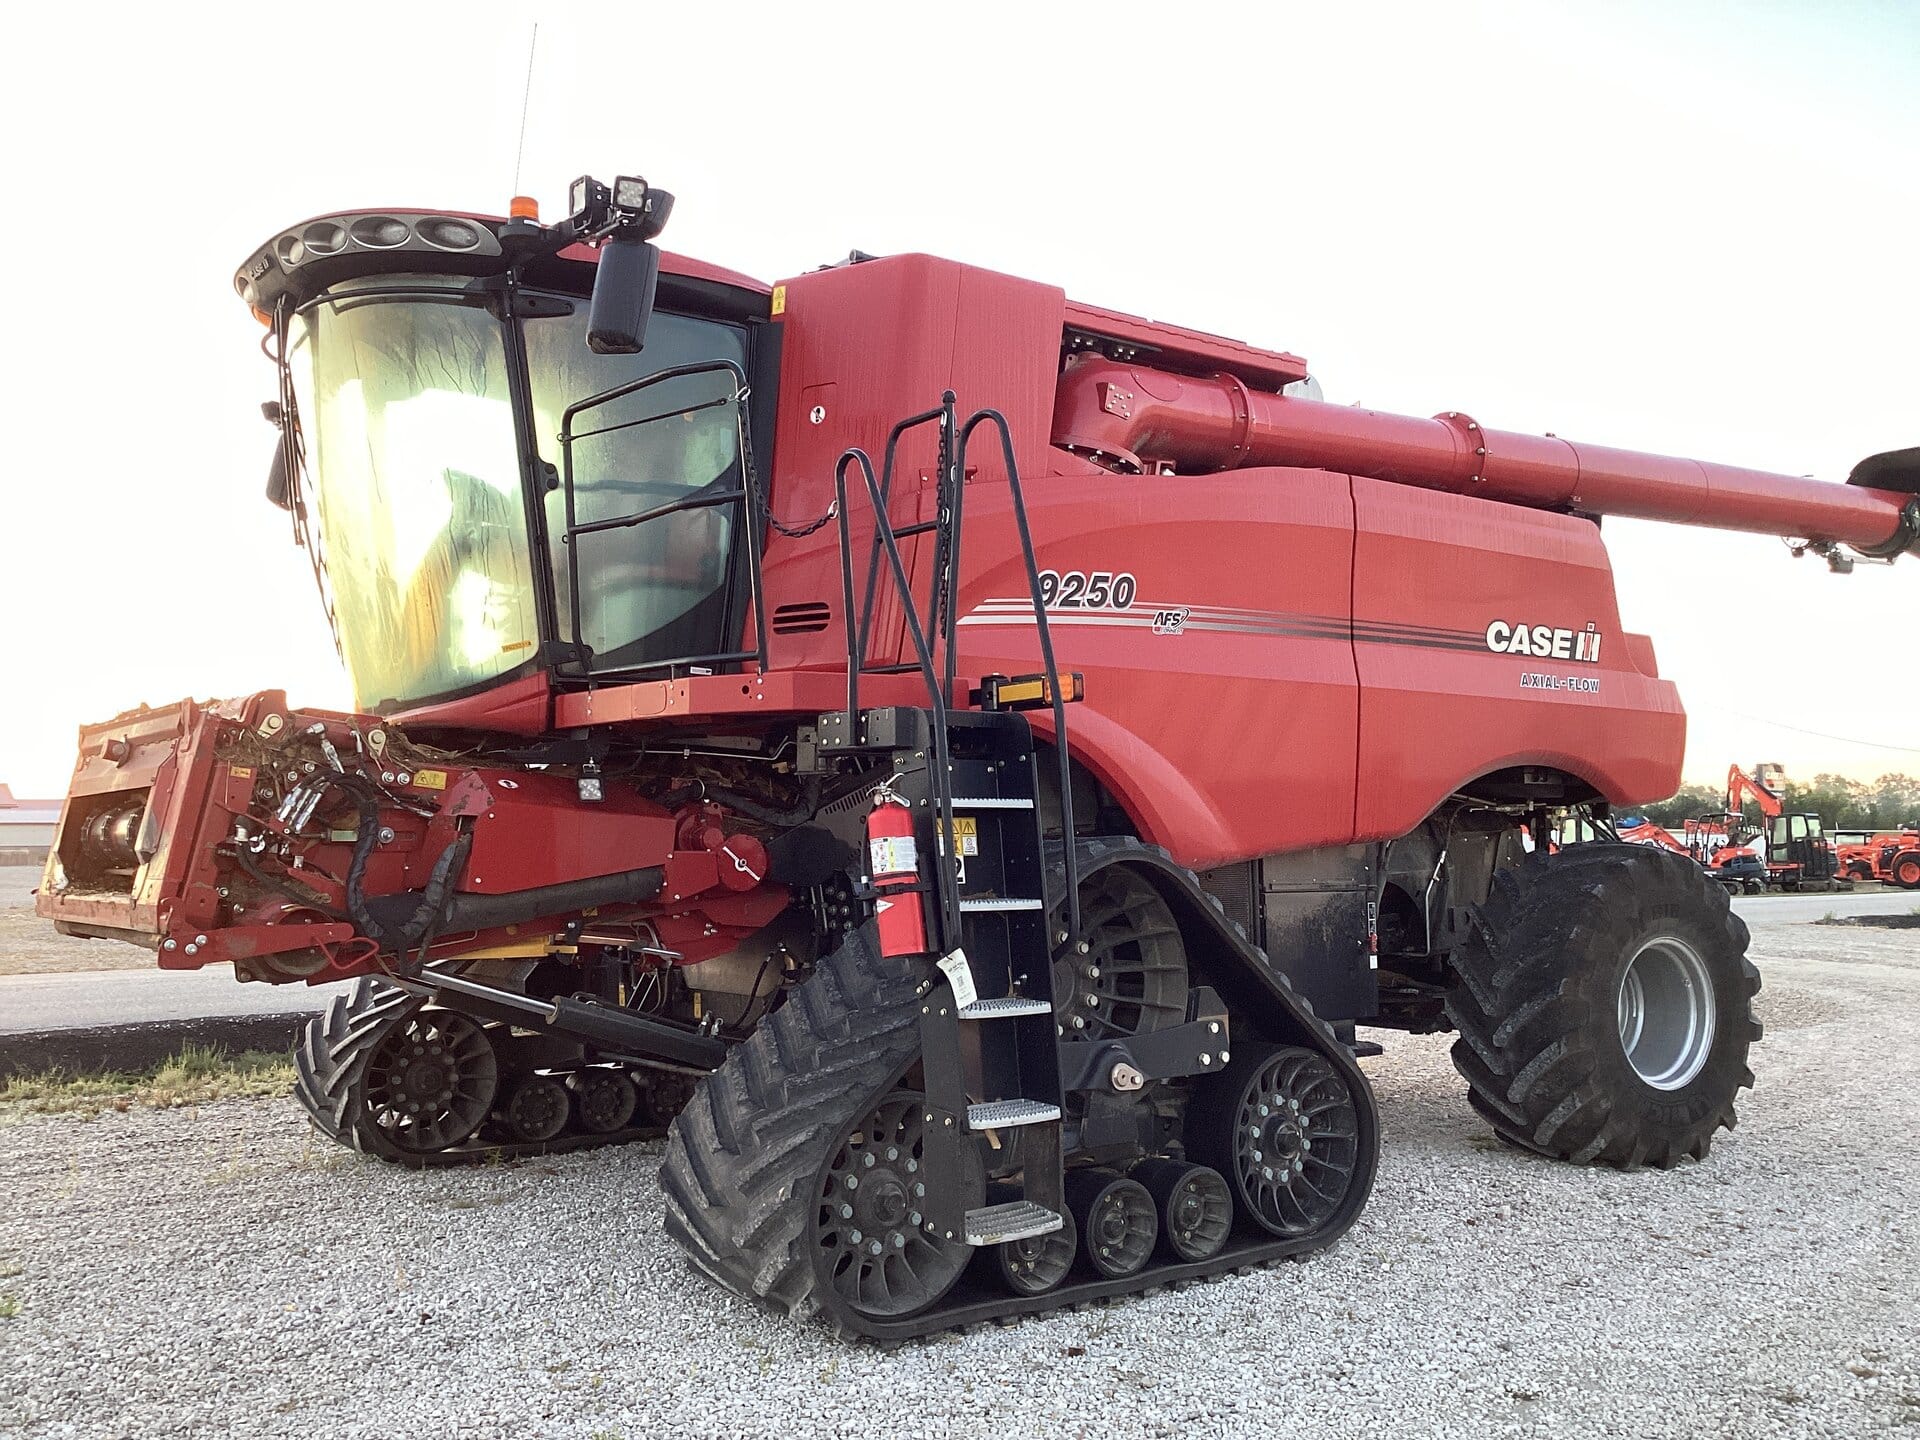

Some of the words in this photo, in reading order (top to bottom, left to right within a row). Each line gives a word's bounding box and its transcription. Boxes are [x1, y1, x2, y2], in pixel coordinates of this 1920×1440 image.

[1038, 570, 1136, 611] 9250
[1153, 611, 1181, 627] AFS
[1486, 621, 1573, 659] CASE
[1520, 673, 1599, 693] AXIAL-FLOW
